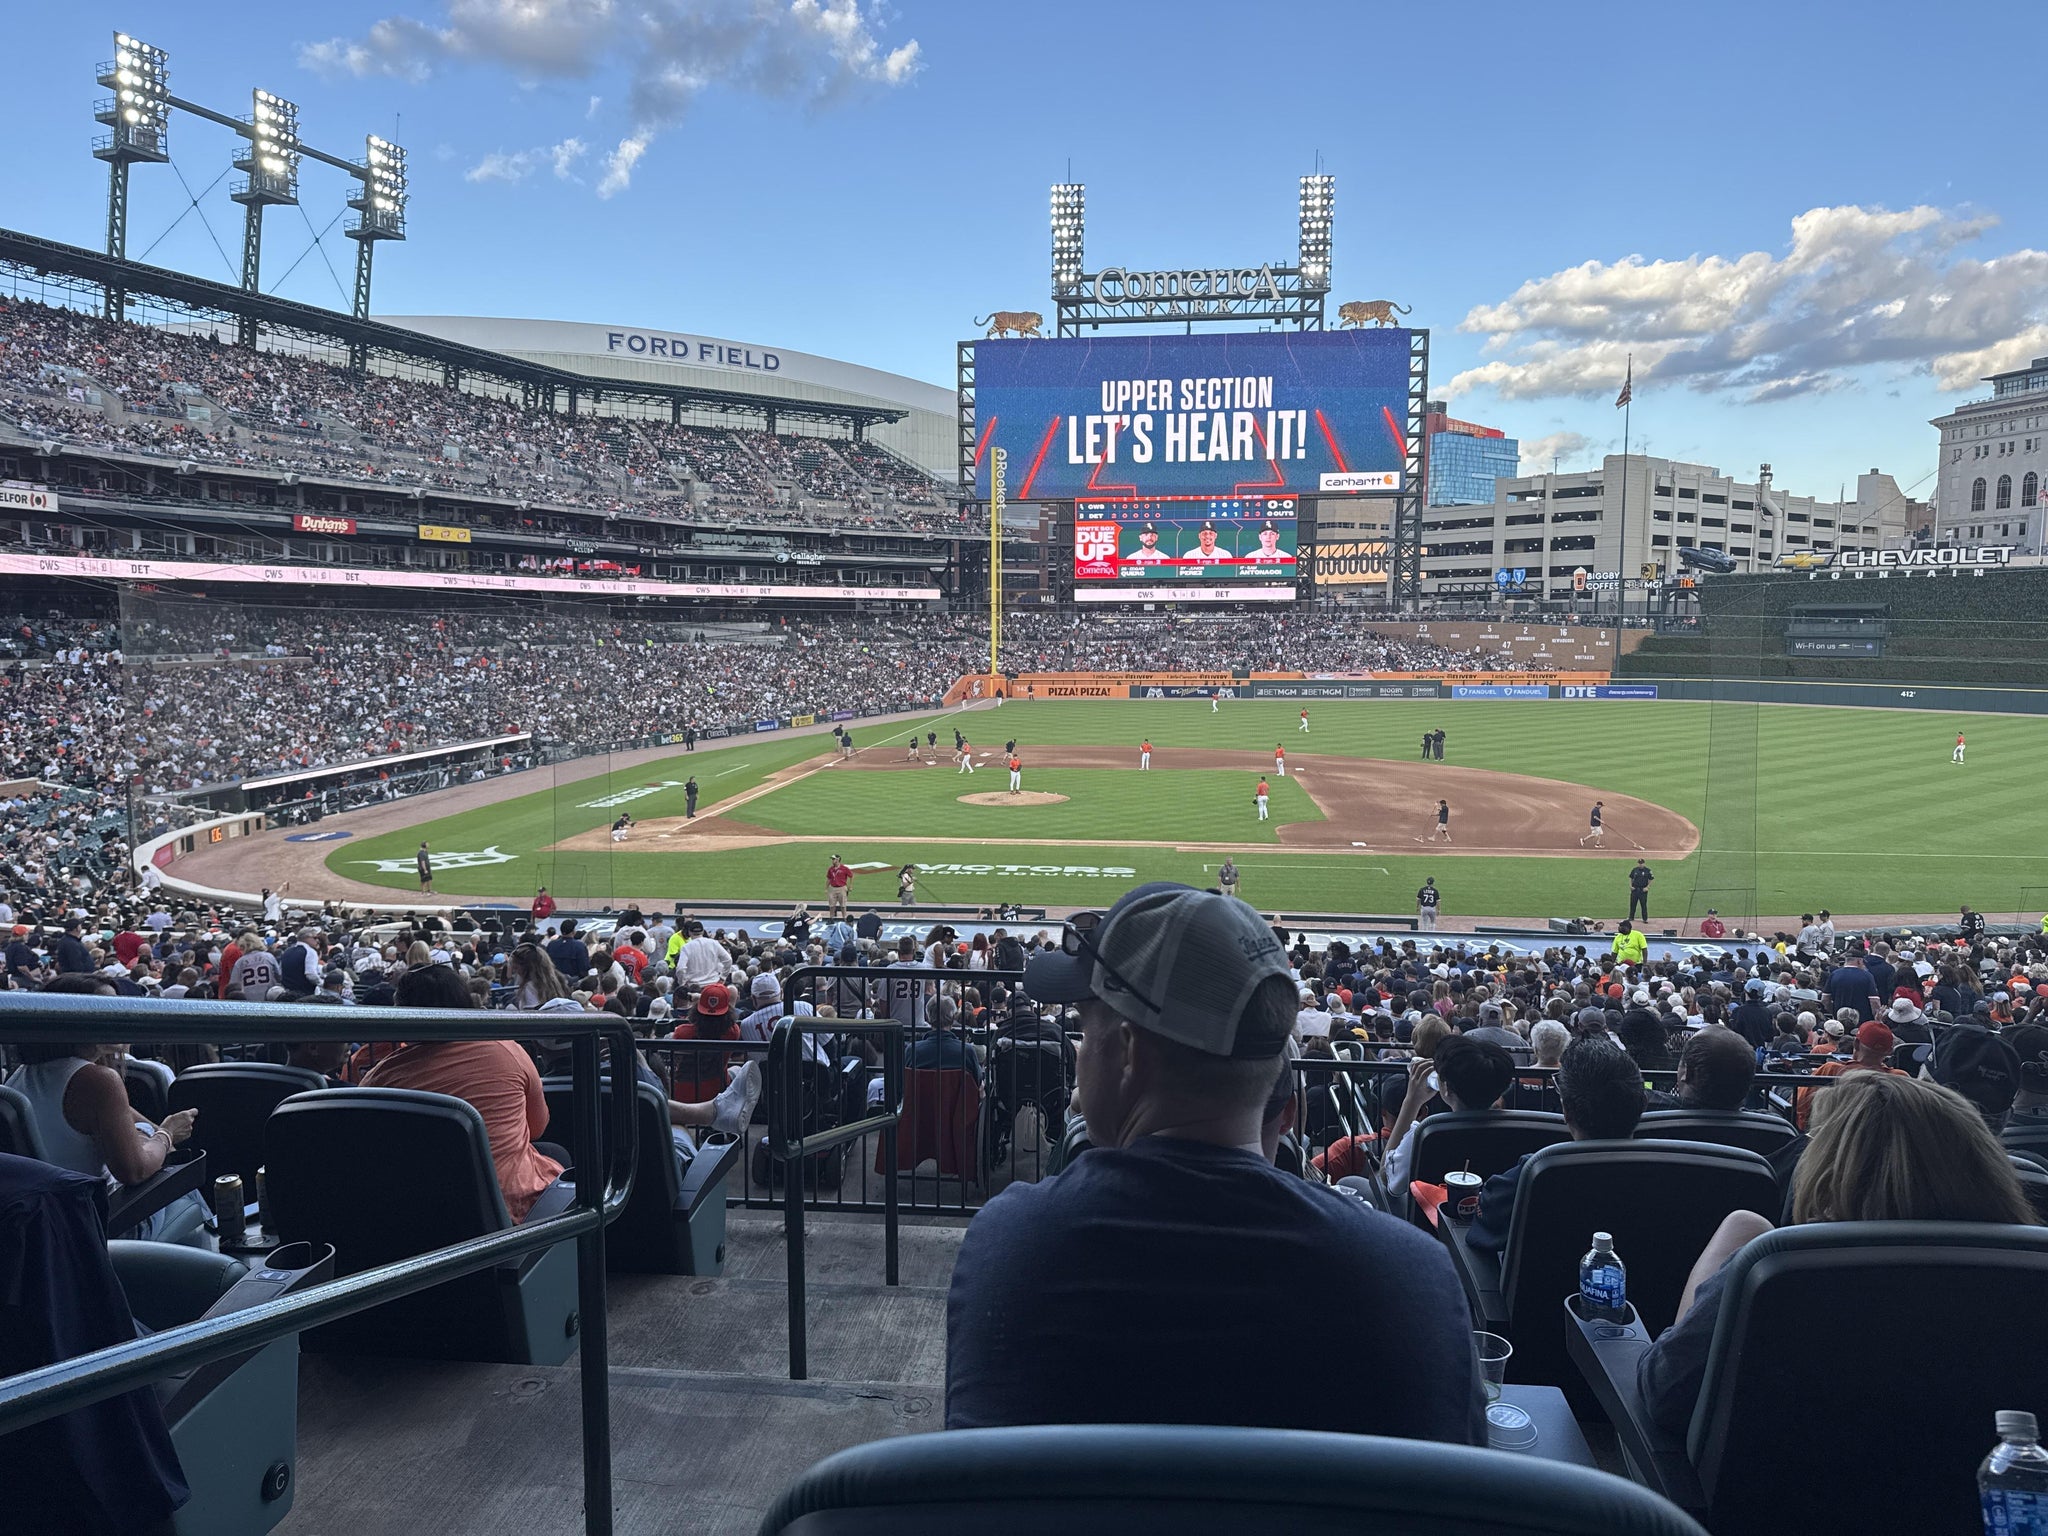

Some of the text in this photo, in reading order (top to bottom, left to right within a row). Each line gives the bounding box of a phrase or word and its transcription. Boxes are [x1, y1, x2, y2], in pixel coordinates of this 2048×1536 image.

[1145, 298, 1233, 315] PARK
[608, 331, 780, 371] FORD FIELD
[1102, 376, 1273, 412] UPPER SECTION
[1068, 409, 1307, 464] LET'S HEAR IT!
[996, 461, 1007, 509] Rocket
[1325, 477, 1382, 487] carhartt
[1267, 500, 1294, 509] 0-0
[301, 515, 349, 531] Dunham's
[1077, 532, 1115, 543] DUE
[566, 539, 599, 549] CHAMPIONS
[790, 552, 826, 561] Gallagher
[1076, 543, 1116, 561] UP
[1841, 546, 2017, 567] CHEVROLET
[39, 559, 150, 575] CWS DET
[264, 569, 360, 582] CWS DET
[1586, 572, 1620, 580] BIGGBY
[1809, 568, 1985, 580] FOUNTAIN
[443, 576, 516, 588] CWS DET
[1586, 582, 1620, 590] COFFEE
[696, 586, 772, 595] CWS DET
[1215, 590, 1230, 598] DET
[1418, 624, 1428, 632] 23
[1487, 624, 1492, 632] 5
[1523, 626, 1529, 634] 2
[1559, 628, 1568, 636] 16
[1600, 630, 1606, 639] 6
[1540, 643, 1546, 651] 3
[1048, 687, 1111, 696] PIZZA! PIZZA!
[1263, 688, 1297, 696] BETMGM
[1308, 688, 1342, 696] BETMGM
[1565, 686, 1597, 698] DTE
[661, 733, 684, 744] bet365
[914, 863, 1137, 874] VICTORS
[1423, 894, 1434, 903] 73
[1974, 920, 1984, 929] 23
[242, 965, 270, 986] 29
